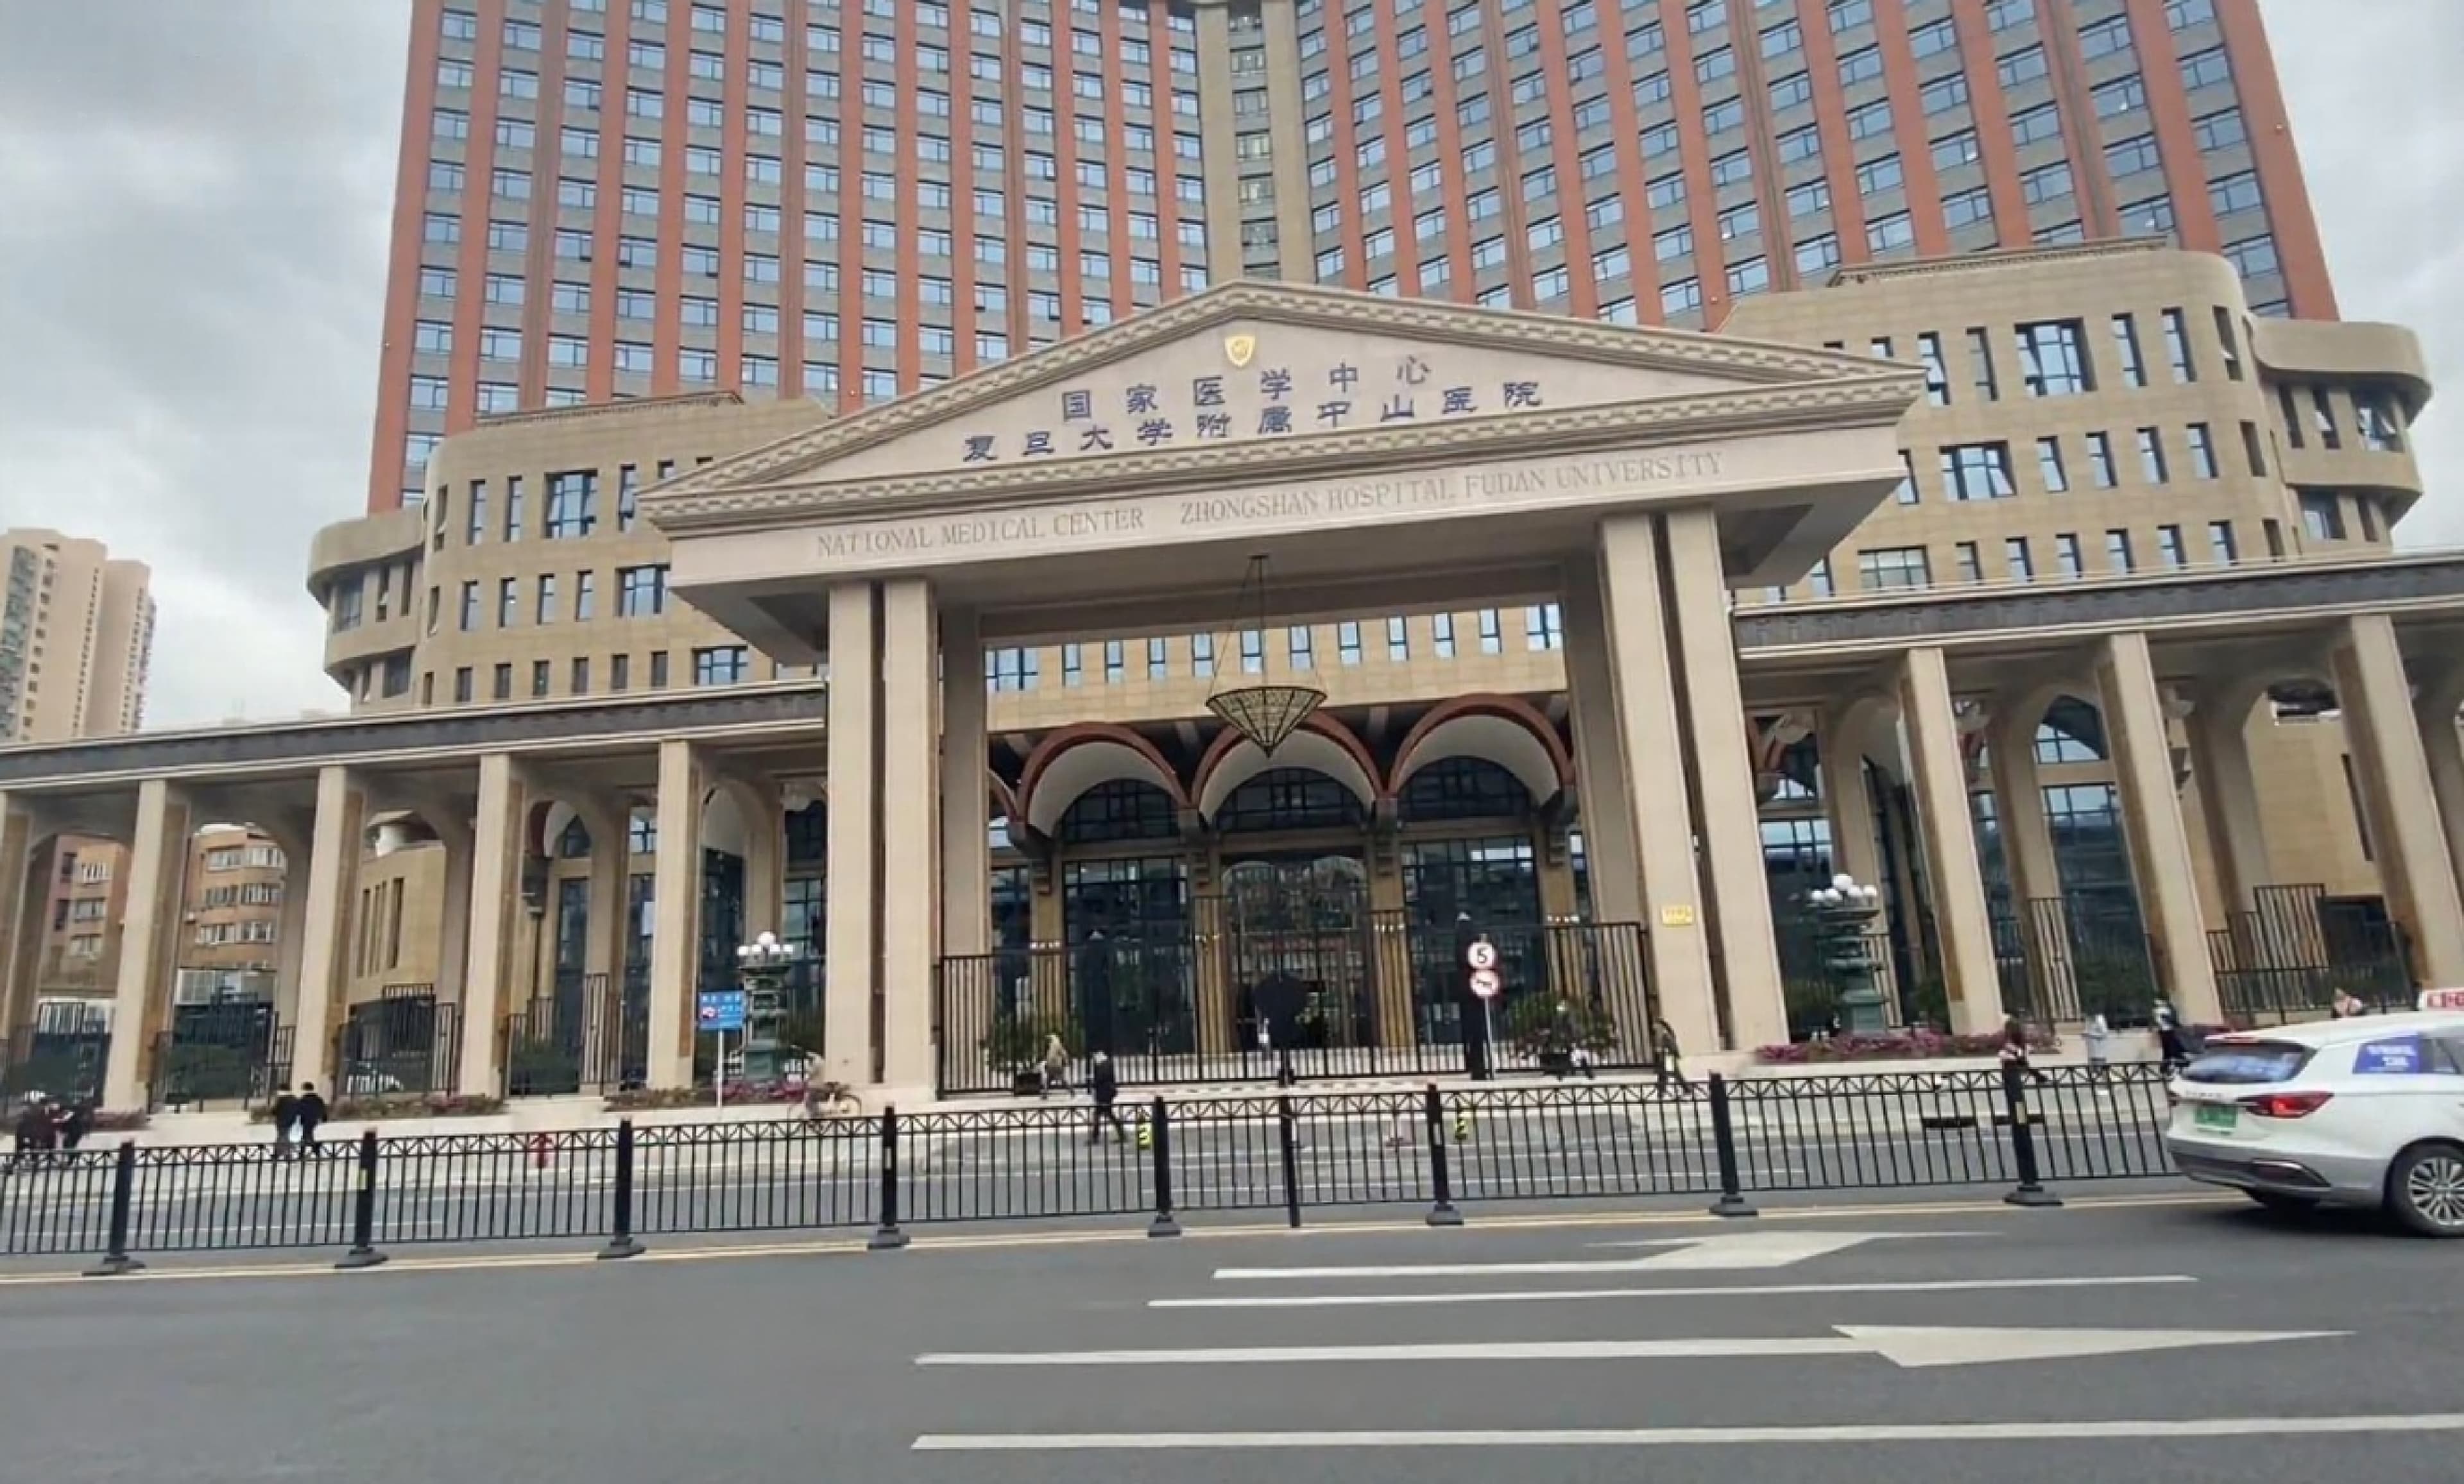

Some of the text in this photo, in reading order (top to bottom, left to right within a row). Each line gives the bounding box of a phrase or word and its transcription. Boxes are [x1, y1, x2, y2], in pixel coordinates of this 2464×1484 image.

[963, 382, 1543, 462] 复旦大学附属中山医院
[1062, 355, 1431, 422] 国家医学中心
[817, 452, 1721, 558] NATIONAL MEDICAL CENTER ZHONGSHAN HOSPITAL FUDAN UNIVERSITY
[1476, 946, 1489, 964] 5
